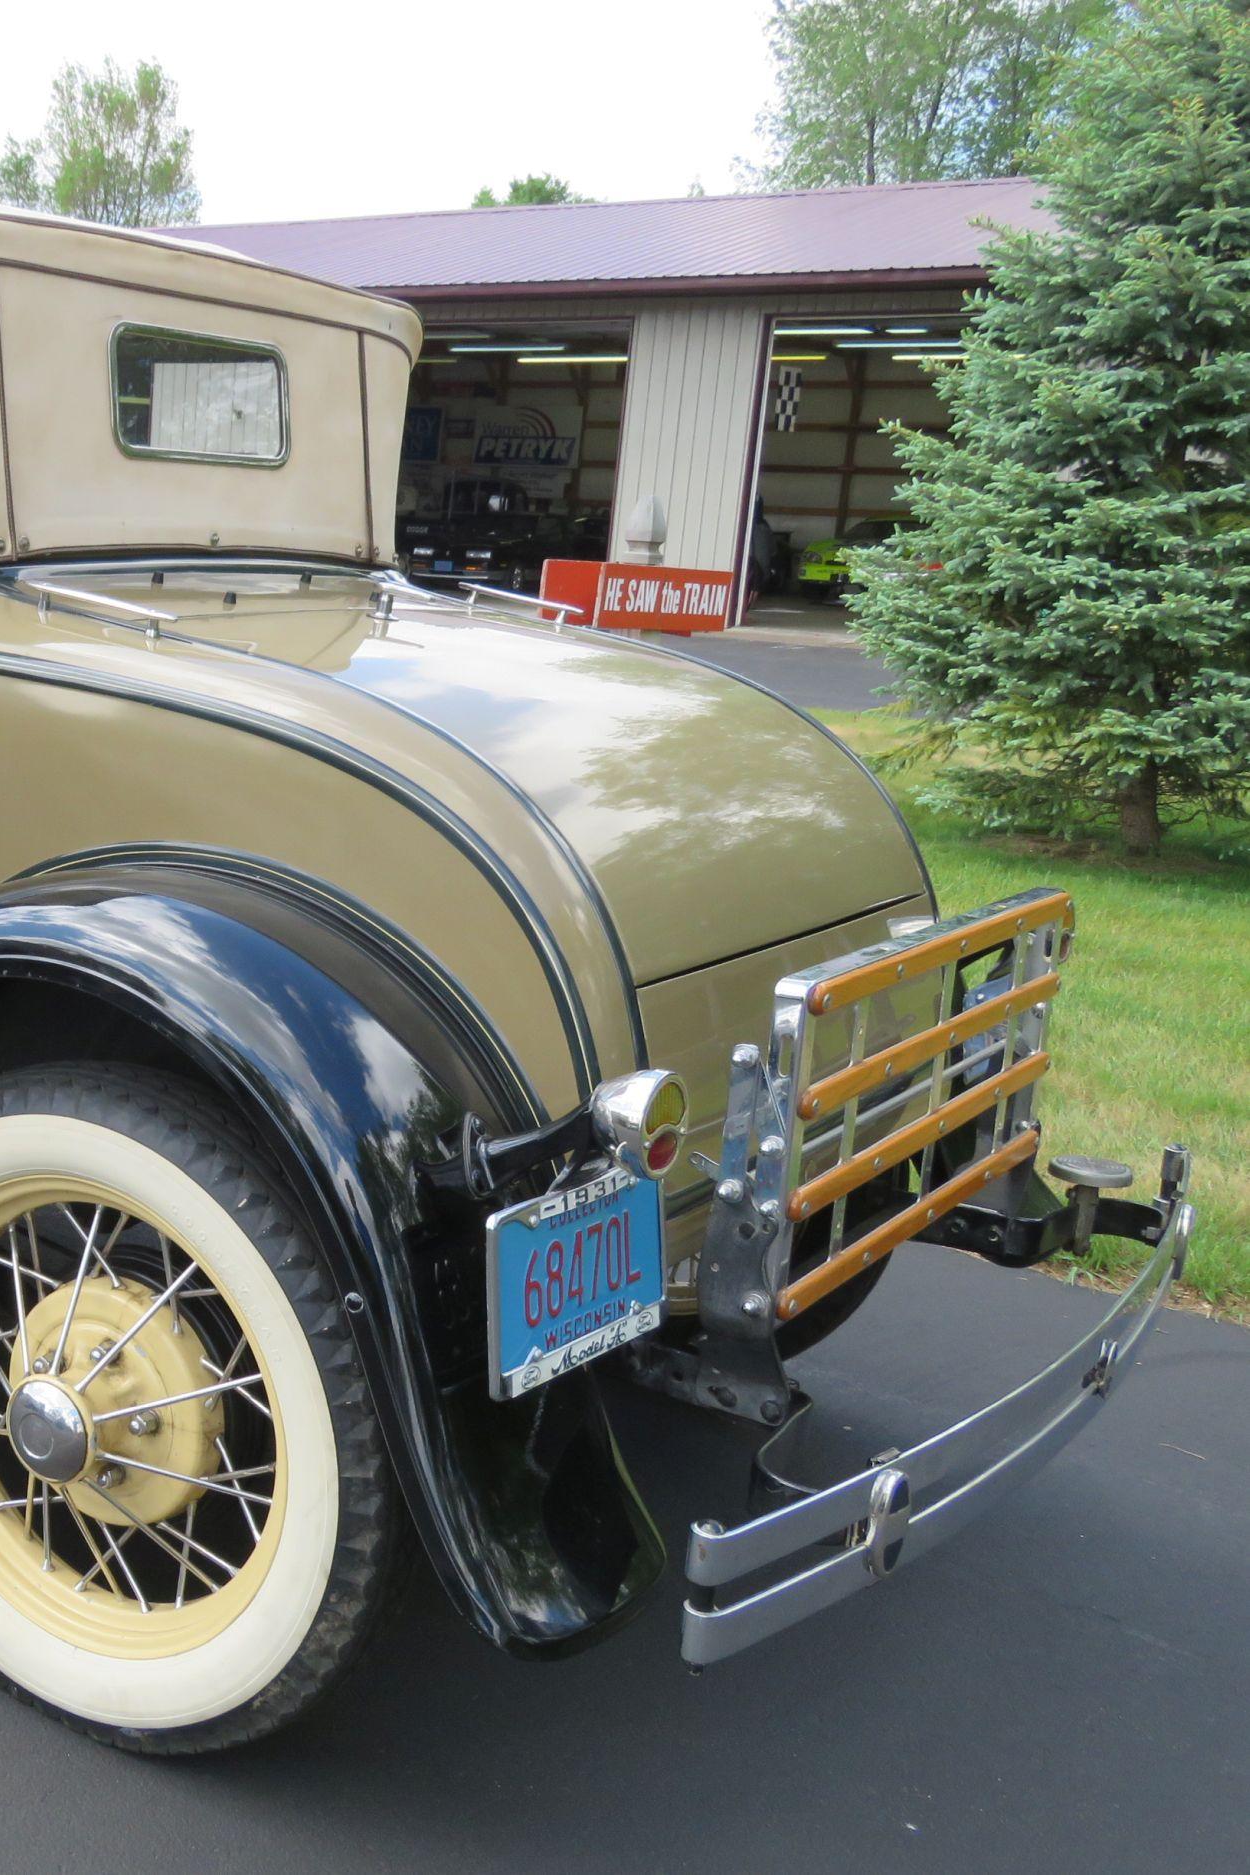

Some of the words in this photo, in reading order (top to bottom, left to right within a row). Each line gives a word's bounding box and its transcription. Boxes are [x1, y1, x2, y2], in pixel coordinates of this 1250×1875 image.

[481, 421, 529, 435] Warren
[479, 437, 570, 459] PETRYK
[604, 578, 625, 611] HE
[626, 579, 660, 614] SAW
[661, 582, 680, 614] the
[682, 582, 727, 616] TRAIN
[524, 1210, 642, 1328] 68470L
[544, 1297, 627, 1350] WISCONSIN
[551, 1335, 605, 1376] Model
